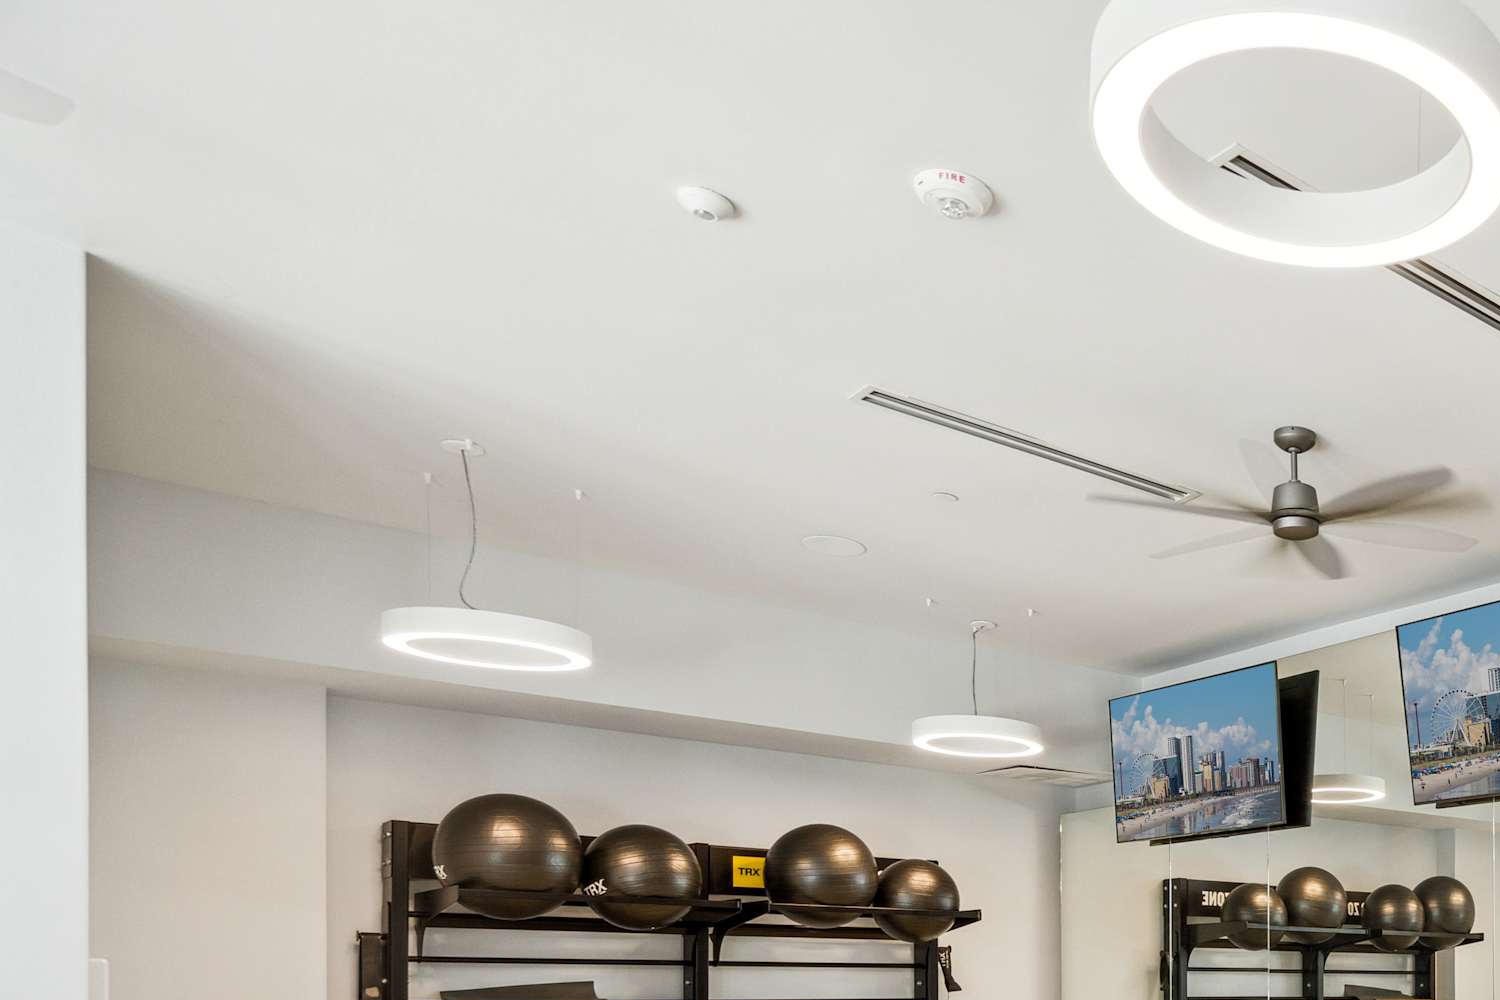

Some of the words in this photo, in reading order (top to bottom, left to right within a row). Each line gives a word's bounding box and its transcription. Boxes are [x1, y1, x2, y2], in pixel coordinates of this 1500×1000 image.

[938, 171, 967, 184] FIRE
[737, 866, 761, 877] TRX
[584, 878, 608, 896] TRX
